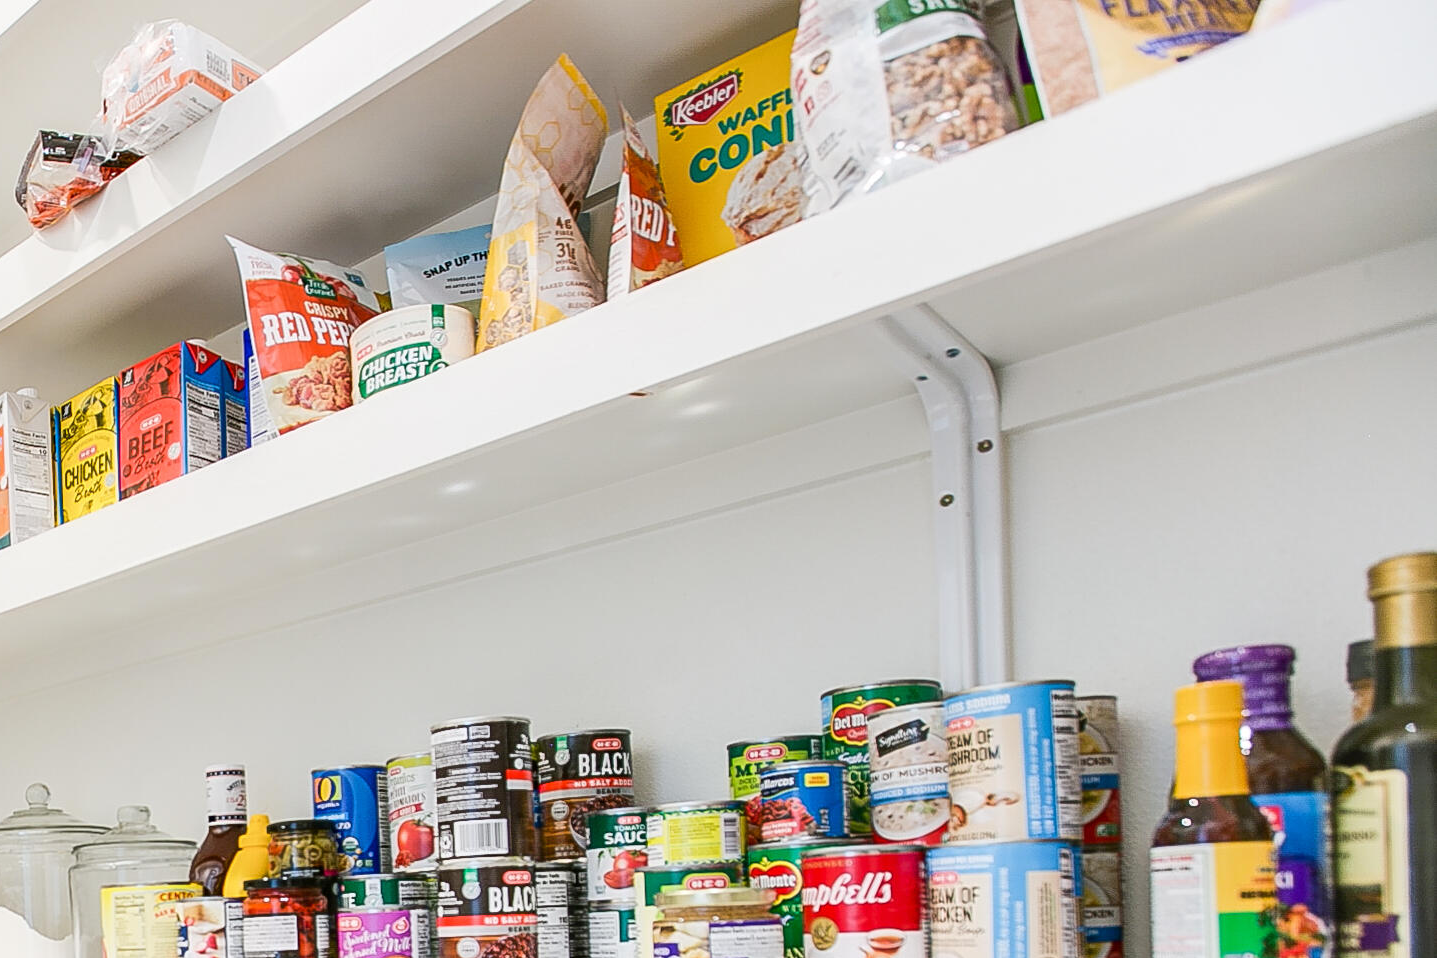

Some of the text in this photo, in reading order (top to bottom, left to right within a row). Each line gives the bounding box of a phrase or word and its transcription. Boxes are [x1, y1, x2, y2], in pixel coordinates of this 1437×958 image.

[676, 83, 733, 123] Keebler
[717, 88, 793, 135] WAFFL
[689, 108, 795, 183] CON
[631, 194, 664, 243] RED
[423, 260, 452, 279] SNAP
[455, 254, 470, 266] UP
[304, 301, 349, 320] CRISPY
[260, 311, 312, 347] RED
[361, 345, 433, 381] CHICKEN
[365, 361, 429, 395] BREAST
[128, 420, 174, 460] BEEF
[65, 449, 113, 490] CHICKEN
[834, 715, 851, 731] Del
[947, 729, 994, 751] EAM OF
[578, 752, 631, 777] BLACK
[949, 746, 1001, 767] SHROOM
[883, 765, 949, 781] OF MUSHRO
[906, 784, 946, 795] SODIUM
[604, 831, 647, 845] SAUC
[762, 874, 796, 888] Monte
[803, 871, 893, 913] mpbell's
[930, 886, 980, 904] EAM OF
[932, 907, 972, 924] ICKEN
